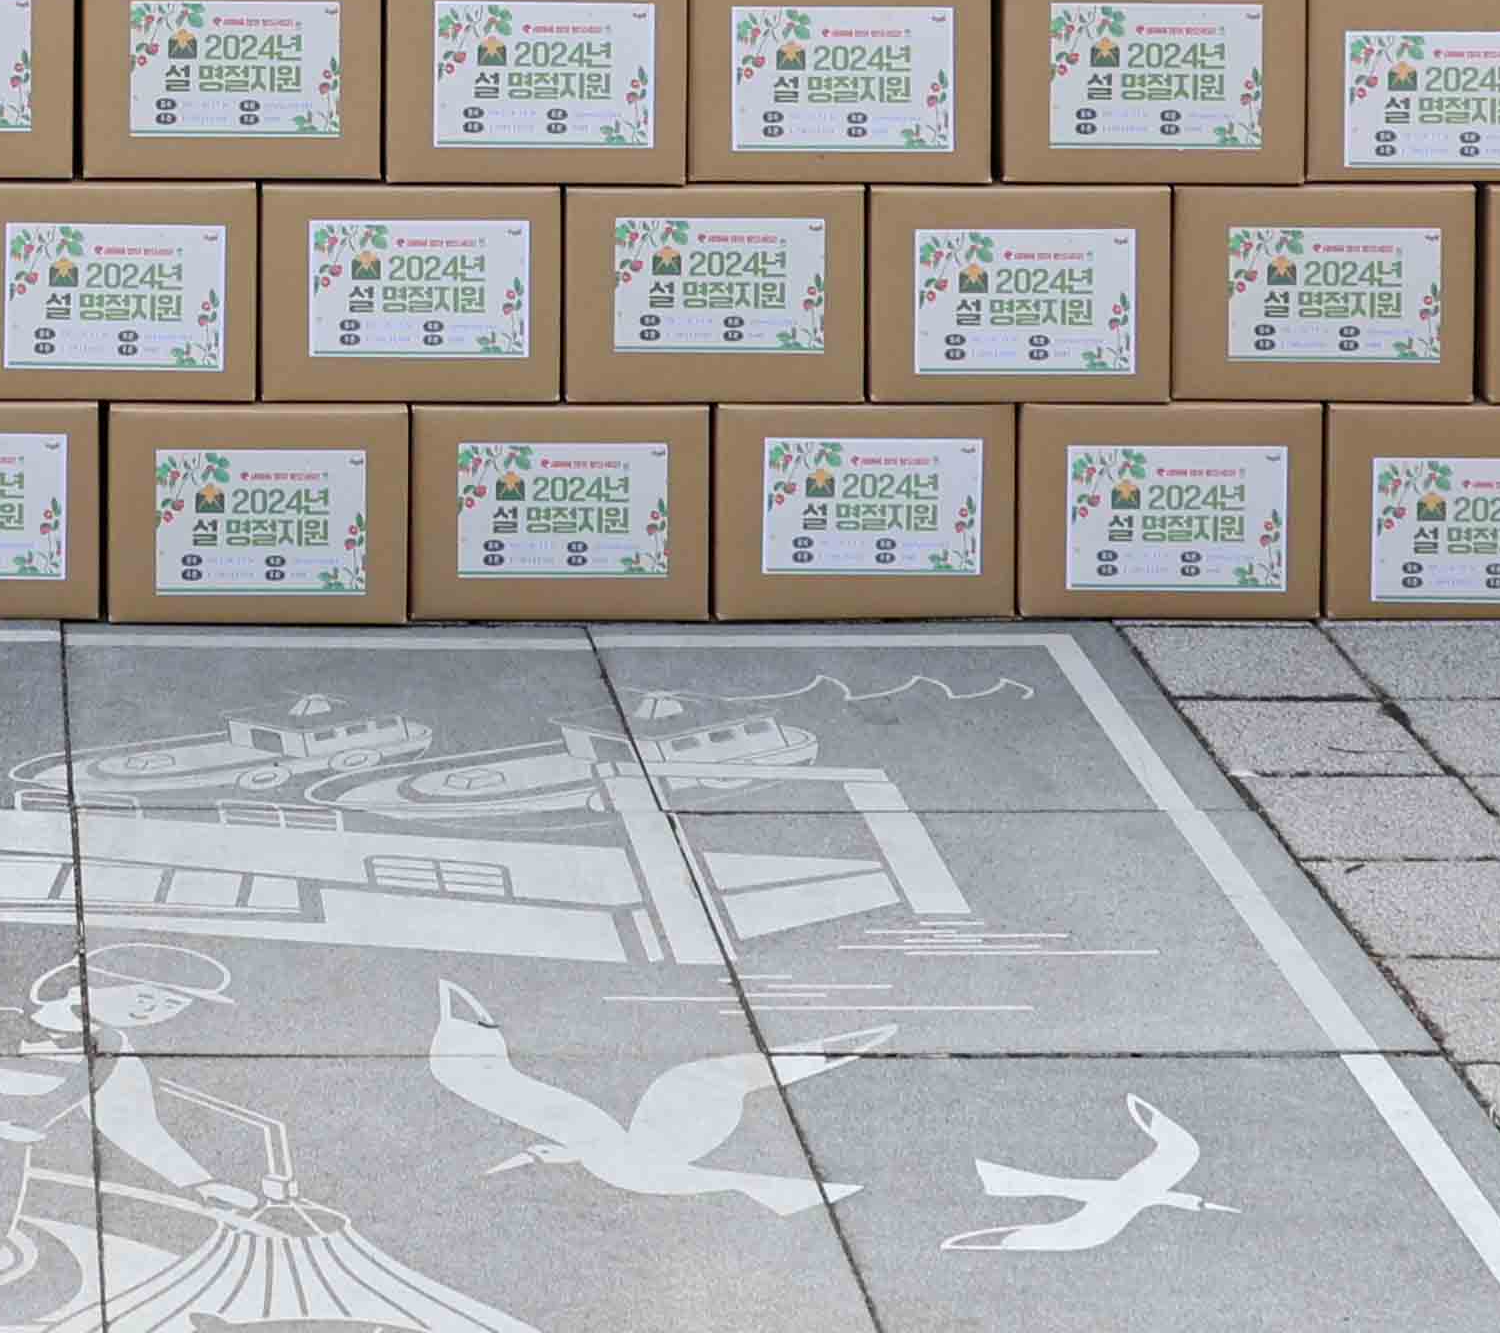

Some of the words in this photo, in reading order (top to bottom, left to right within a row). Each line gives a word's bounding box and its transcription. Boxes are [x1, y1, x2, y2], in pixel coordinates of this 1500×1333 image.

[205, 35, 301, 61] 2024년
[813, 45, 911, 71] 2024년
[166, 64, 190, 91] 설
[199, 65, 301, 91] 명절지원
[772, 76, 798, 103] 설
[807, 76, 910, 103] 명절지원
[1384, 97, 1410, 123] 설
[689, 252, 785, 277] 2024년
[1304, 262, 1401, 287] 2024년
[650, 281, 675, 307] 설
[683, 282, 785, 307] 명절지원
[1264, 291, 1290, 317] 설
[1298, 291, 1401, 317] 명절지원
[232, 488, 328, 514] 2024년
[192, 519, 217, 547] 설
[226, 519, 327, 546] 명절지원
[1412, 527, 1438, 554] 설
